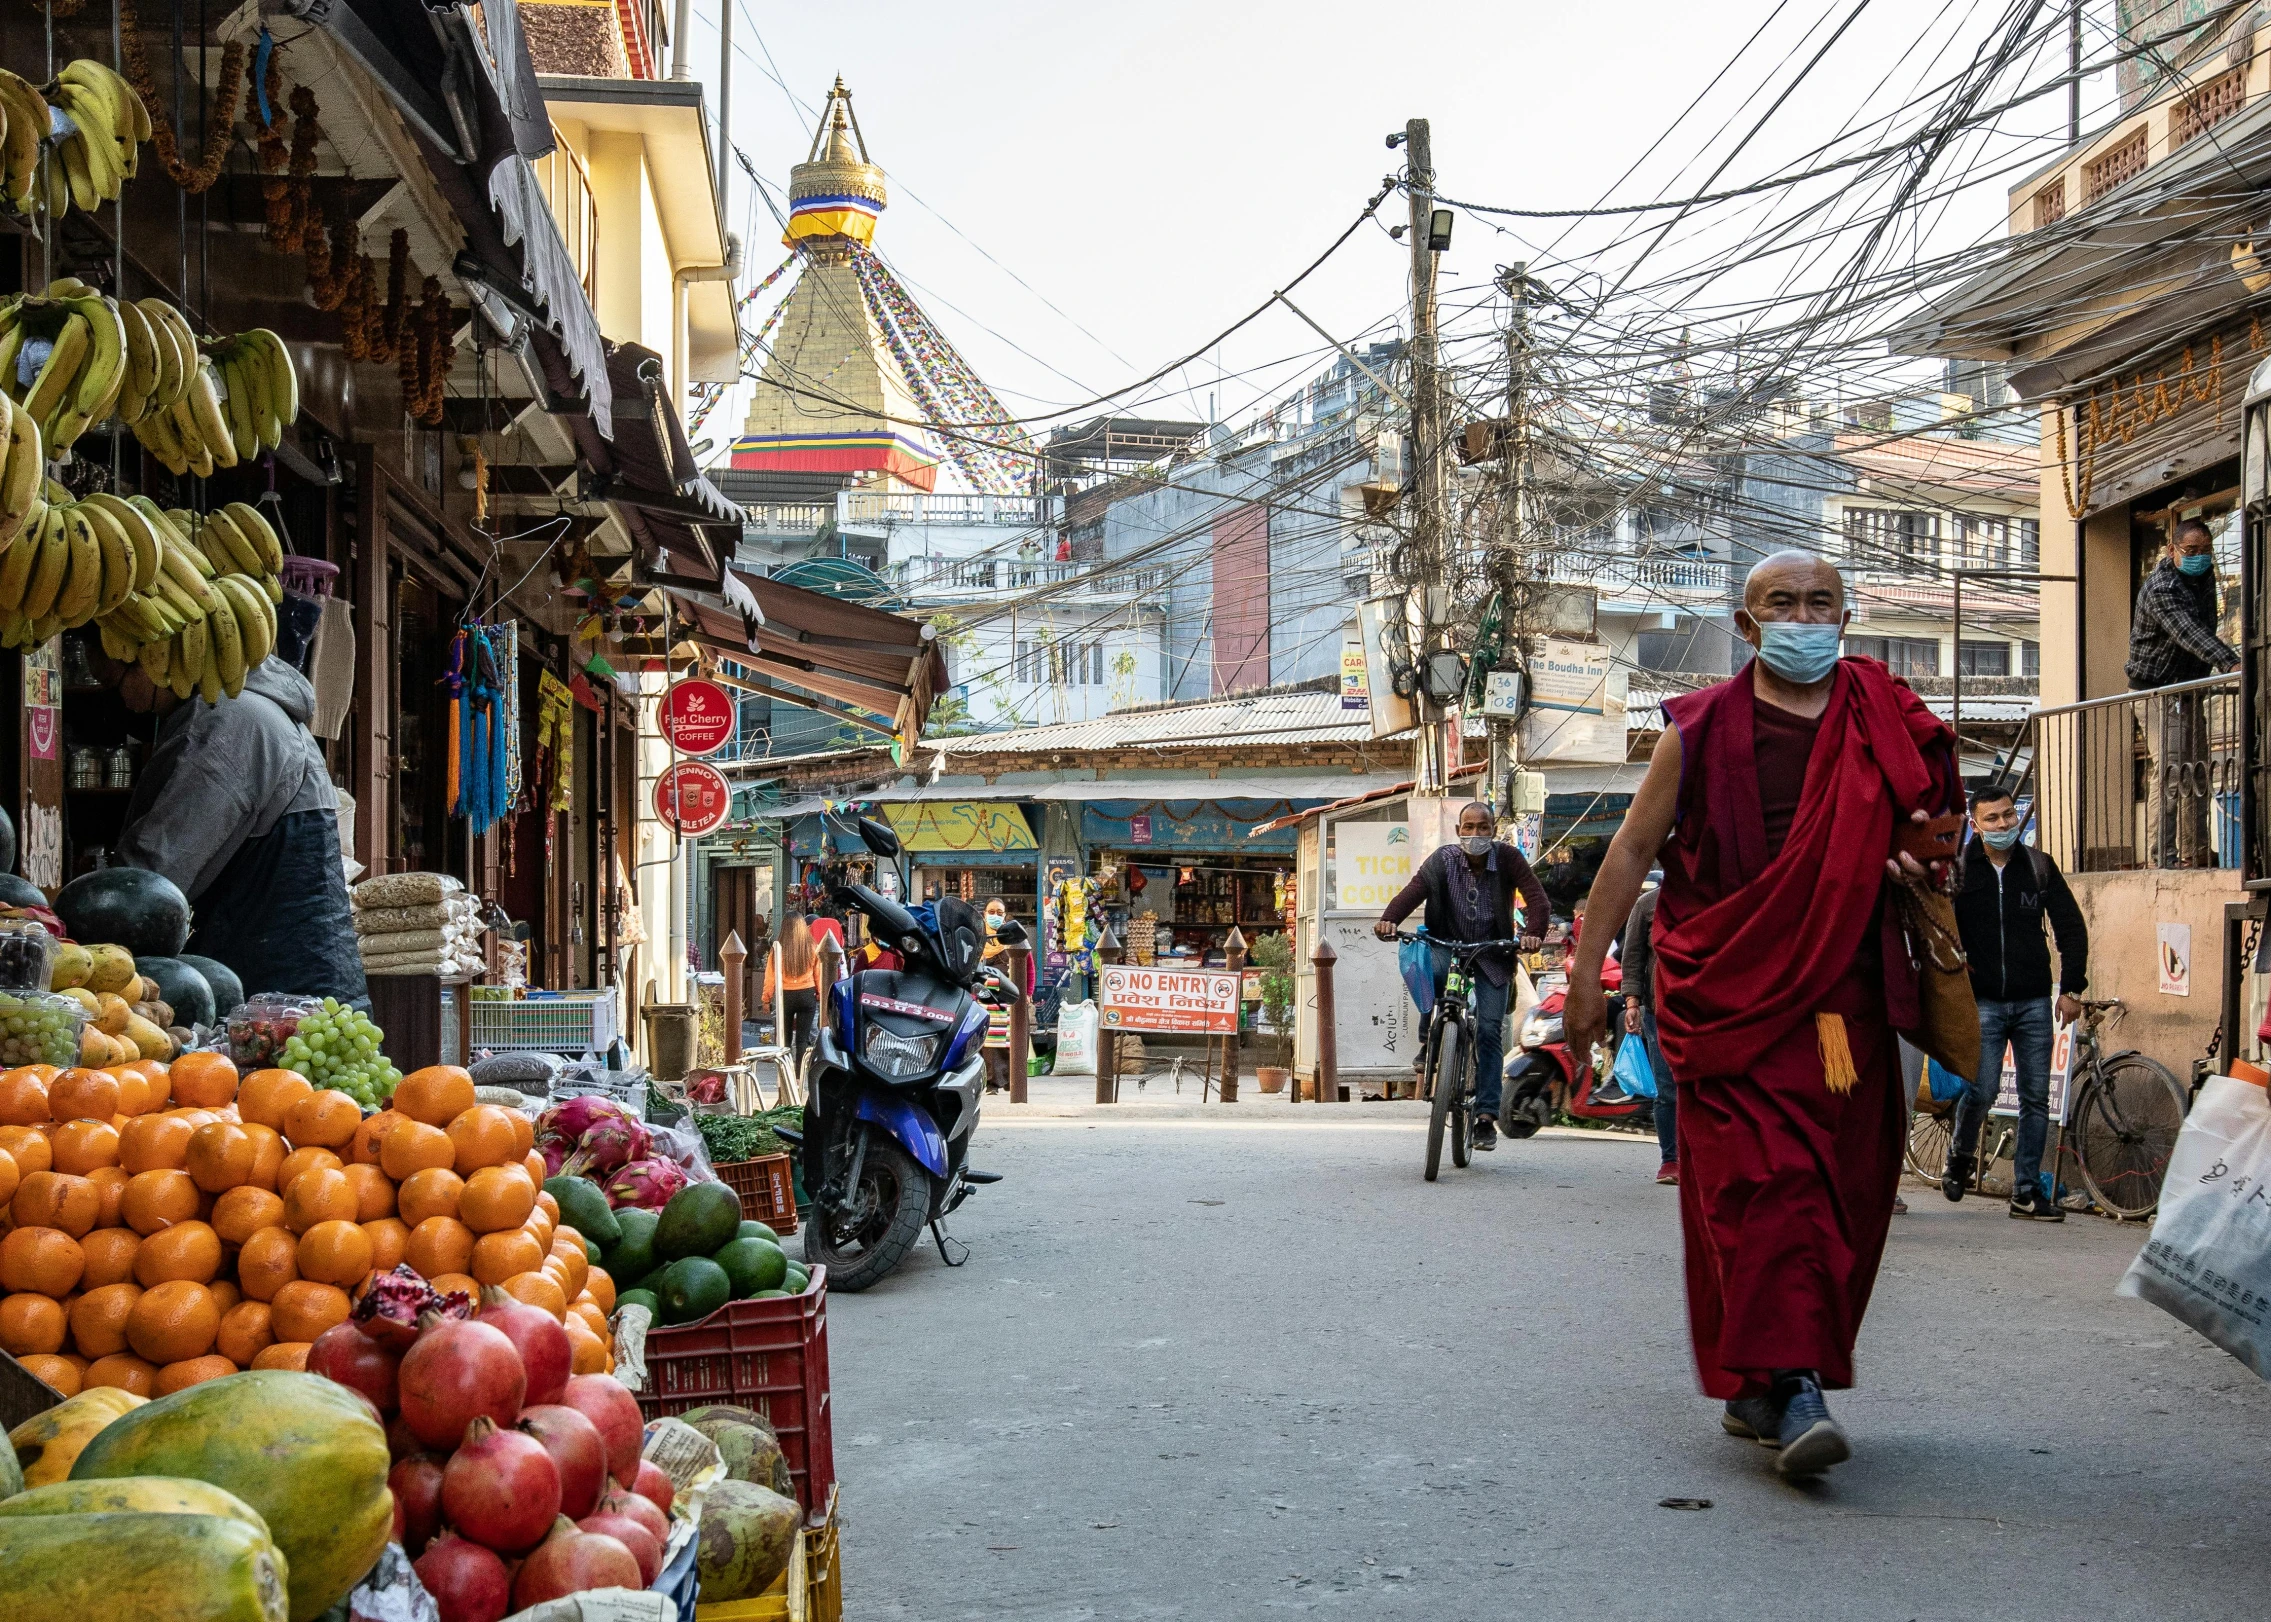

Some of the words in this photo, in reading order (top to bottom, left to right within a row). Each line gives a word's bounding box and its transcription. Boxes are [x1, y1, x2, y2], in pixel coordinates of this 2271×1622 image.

[1344, 658, 1364, 667] CAR
[1527, 658, 1545, 670] The
[1548, 660, 1584, 674] Boudha
[1587, 665, 1603, 676] Inn
[1494, 696, 1515, 709] 08
[689, 714, 727, 724] Cherry
[678, 732, 715, 741] COFFEE
[664, 807, 698, 829] BUBLE
[698, 811, 716, 827] TEA
[1129, 973, 1153, 990] NO
[1158, 975, 1212, 994] ENTRY
[1111, 991, 1162, 1006] प्रवेश
